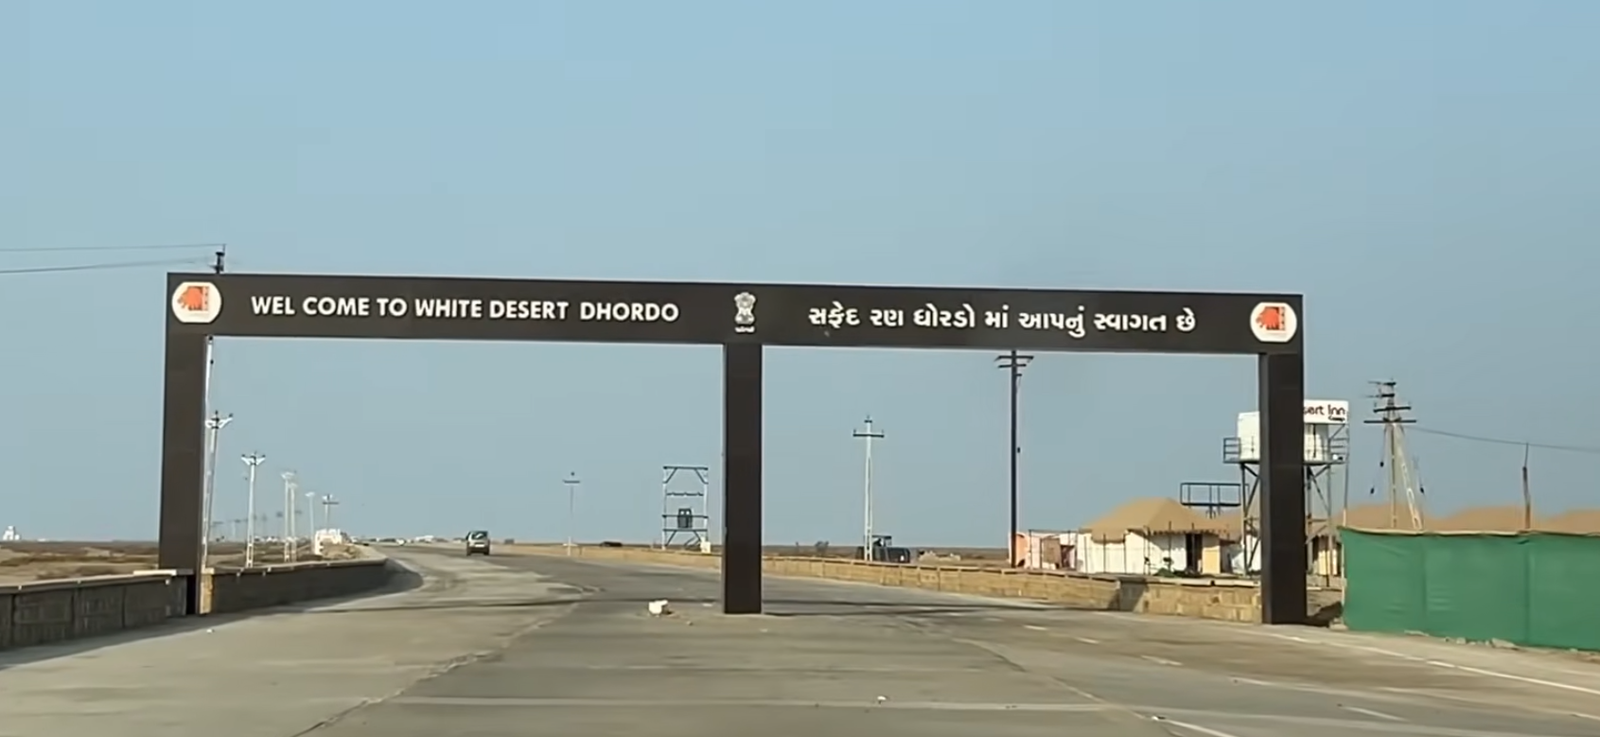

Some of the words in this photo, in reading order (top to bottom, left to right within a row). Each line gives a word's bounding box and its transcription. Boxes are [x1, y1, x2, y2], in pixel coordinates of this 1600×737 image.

[250, 295, 296, 315] WEL
[302, 296, 370, 316] COME
[376, 297, 408, 317] TO
[414, 298, 482, 318] WHITE
[489, 300, 569, 320] DESERT
[580, 301, 679, 322] DHORDO
[808, 301, 861, 329] સફેદ
[869, 309, 904, 327] રણ
[913, 303, 976, 328] ધોરડો
[984, 304, 1009, 329] માં
[1017, 305, 1086, 338] આપનું
[1093, 313, 1167, 331] સ્વાગત
[1175, 307, 1196, 332] છે
[1303, 405, 1325, 416] sert
[1327, 404, 1346, 415] Inn
